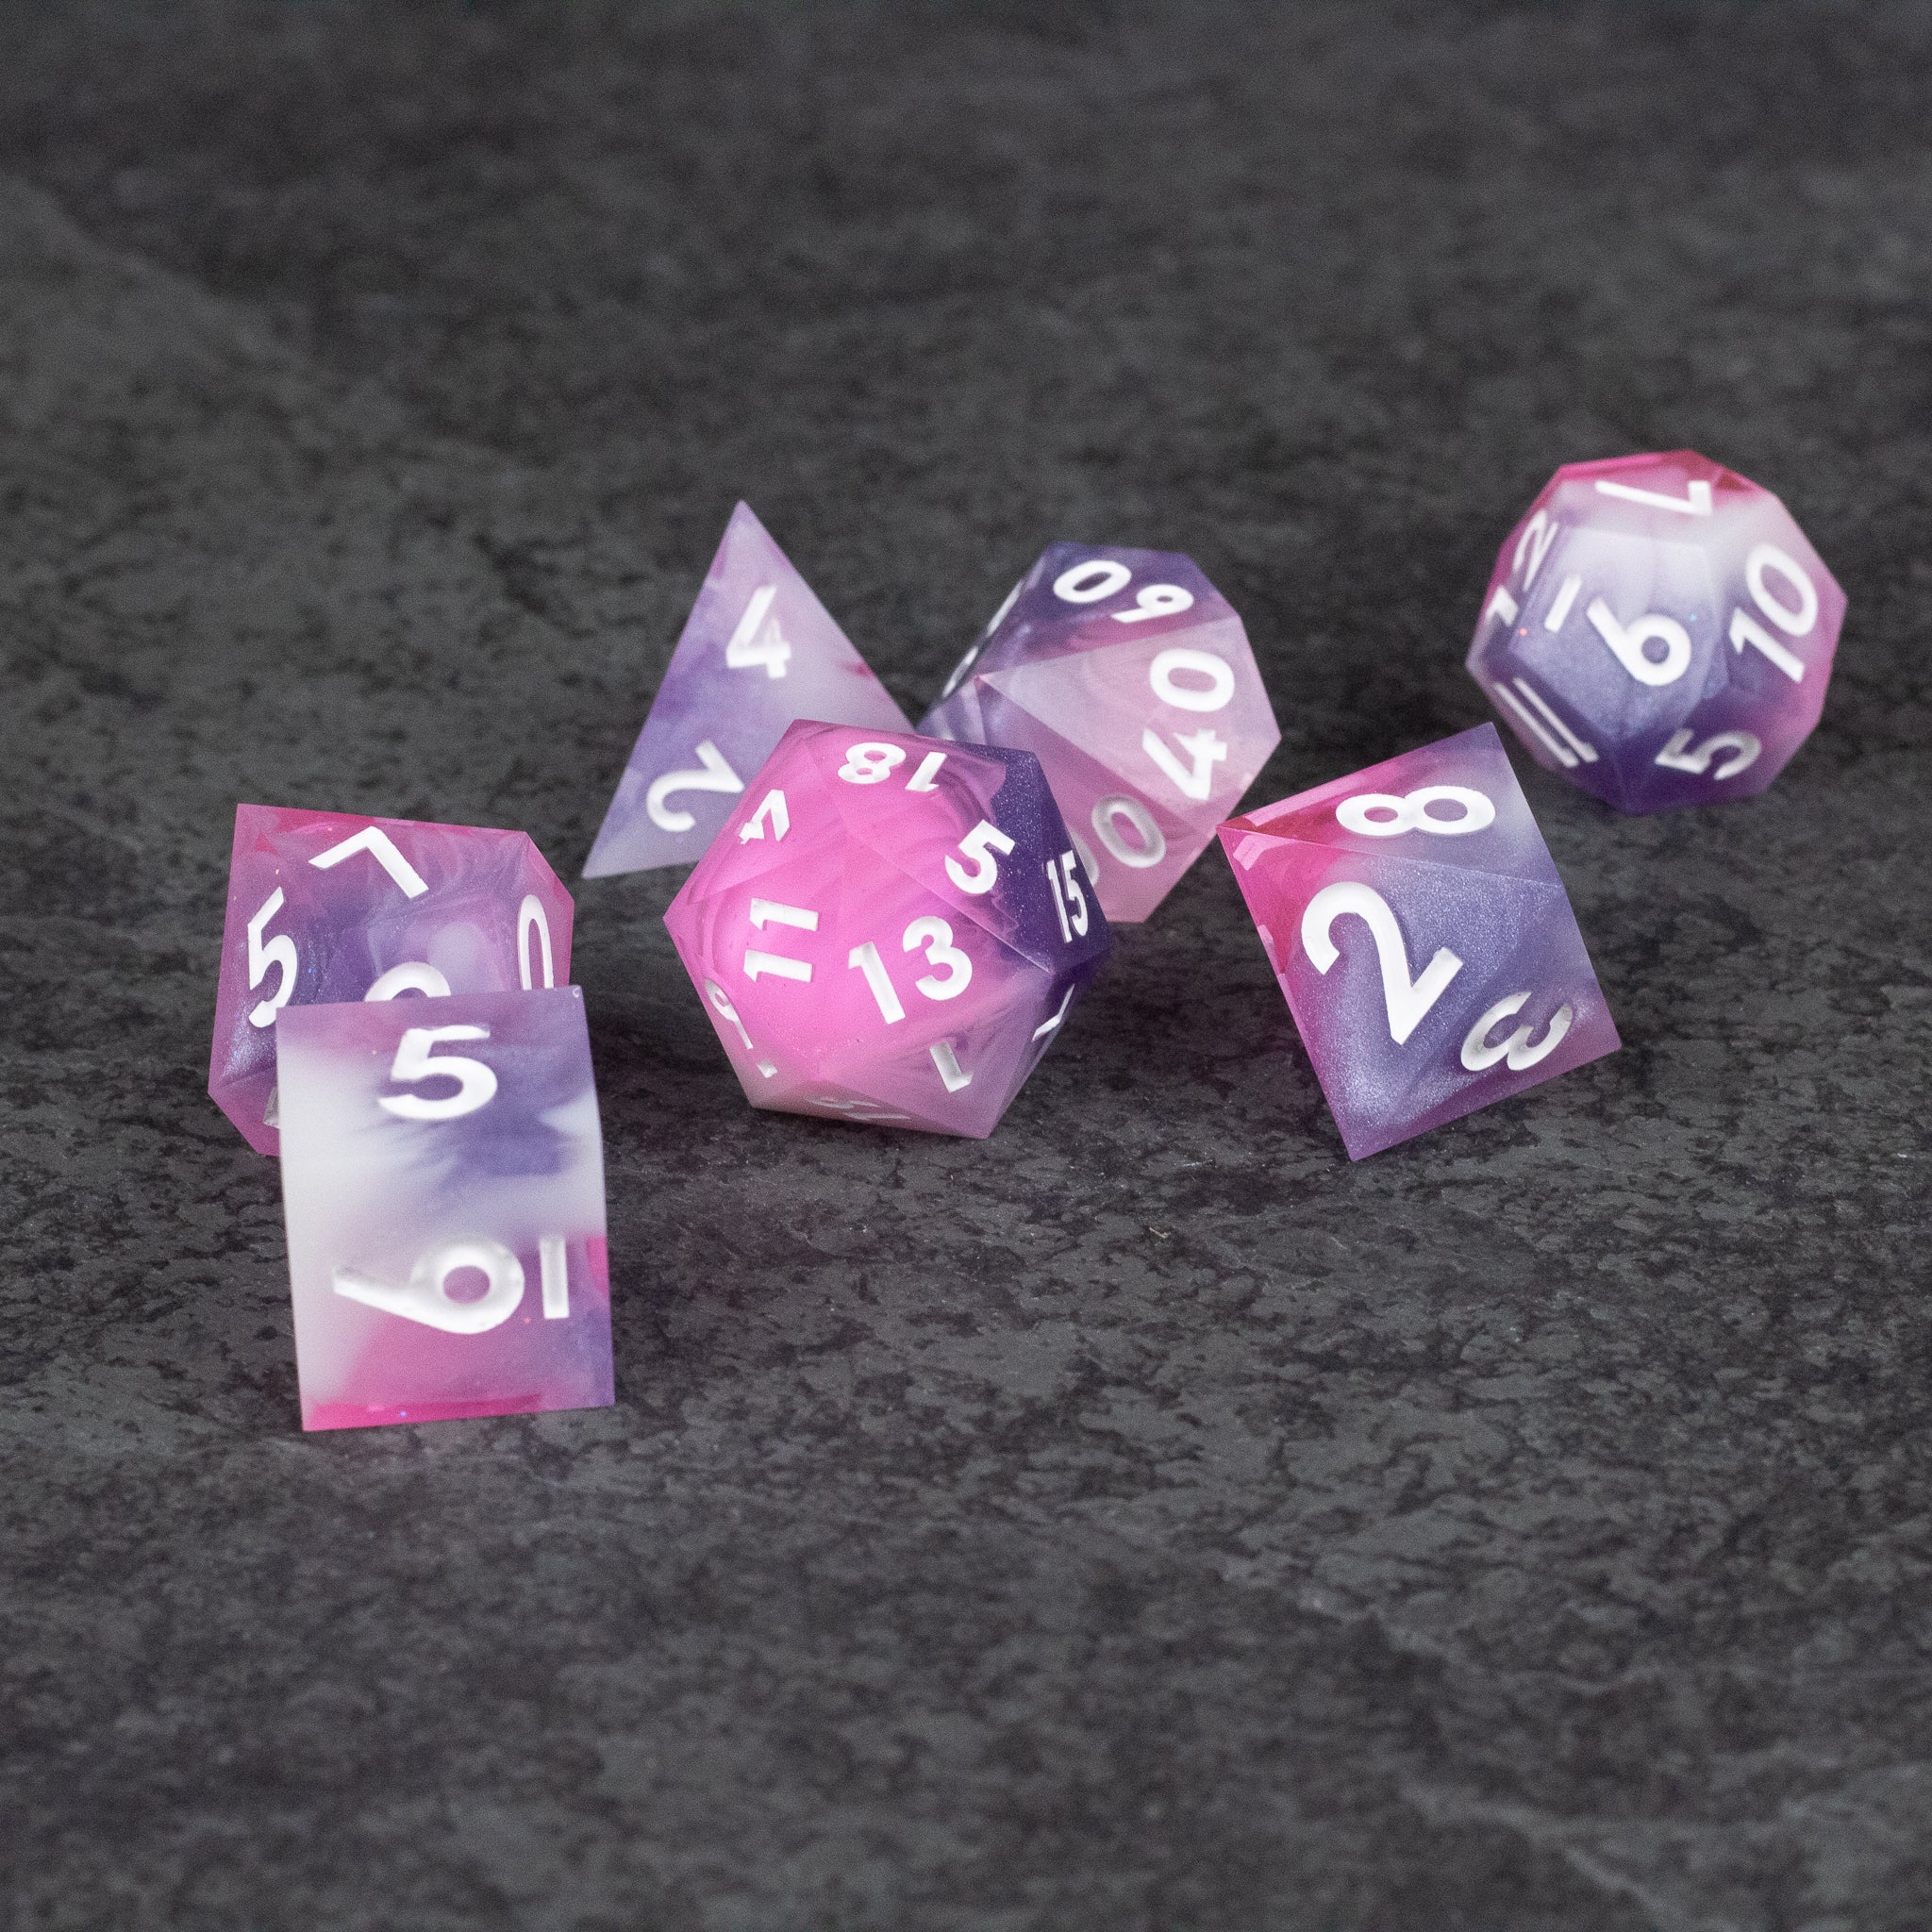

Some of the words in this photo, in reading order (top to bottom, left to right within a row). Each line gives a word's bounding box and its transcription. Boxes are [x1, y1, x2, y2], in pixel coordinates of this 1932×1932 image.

[1596, 480, 1713, 516] 7
[726, 585, 791, 679] 4
[1730, 543, 1819, 683] 10
[838, 741, 947, 792] 18
[1142, 648, 1236, 800] 40
[1494, 677, 1598, 769] 11
[1655, 729, 1762, 780] 5
[646, 740, 744, 833] 2
[1335, 785, 1496, 837] 8
[308, 825, 428, 899] 7
[944, 819, 1015, 895] 5
[1046, 850, 1089, 943] 15
[247, 885, 298, 1028] 5
[743, 897, 819, 983] 11
[848, 915, 973, 1024] 13
[1300, 881, 1464, 1046] 2
[378, 1024, 498, 1120] 5
[1460, 991, 1574, 1073] 3
